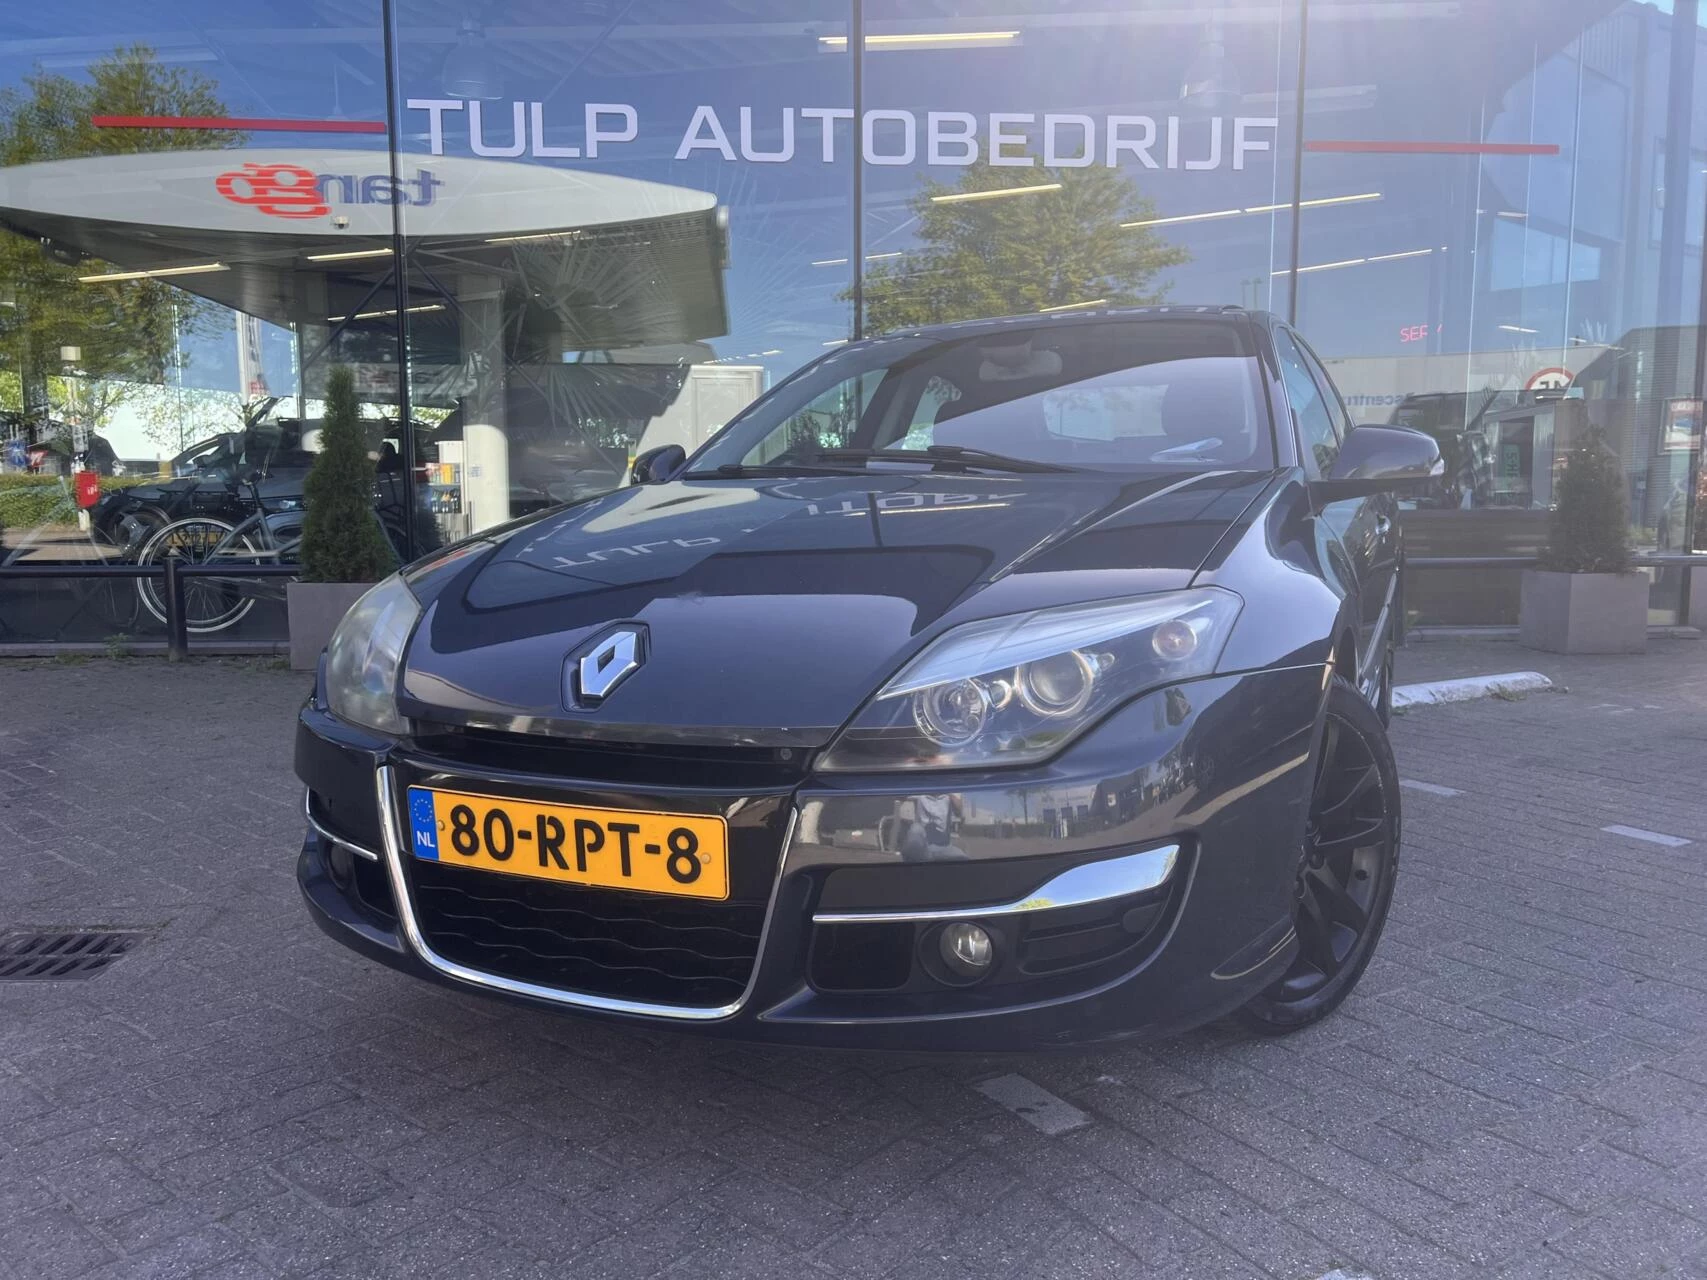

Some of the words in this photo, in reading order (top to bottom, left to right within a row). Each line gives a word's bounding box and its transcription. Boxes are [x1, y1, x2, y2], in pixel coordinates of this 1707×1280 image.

[407, 99, 638, 158] TULP
[675, 105, 1279, 171] AUTOBEDRIJF
[416, 830, 436, 848] NL
[449, 804, 702, 884] 80-RPT-8
